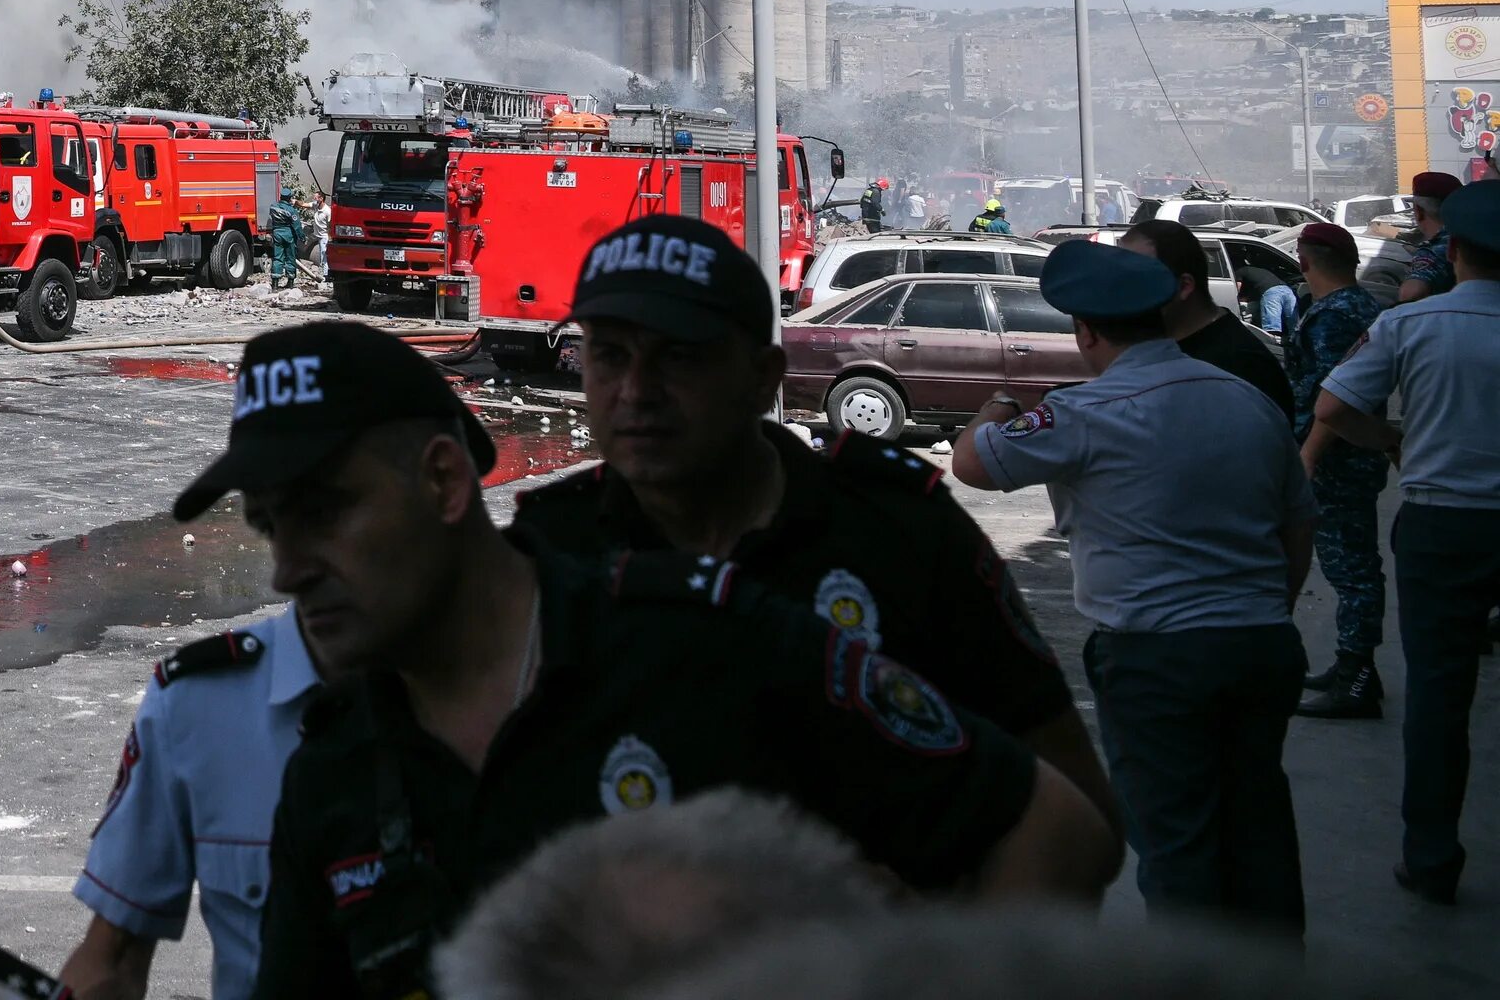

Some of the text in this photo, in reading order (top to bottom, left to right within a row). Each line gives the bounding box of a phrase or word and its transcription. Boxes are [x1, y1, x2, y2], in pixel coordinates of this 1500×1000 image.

[380, 202, 414, 211] ISUZU
[710, 182, 727, 207] 0091
[583, 232, 717, 286] POLICE
[233, 355, 323, 419] LICE
